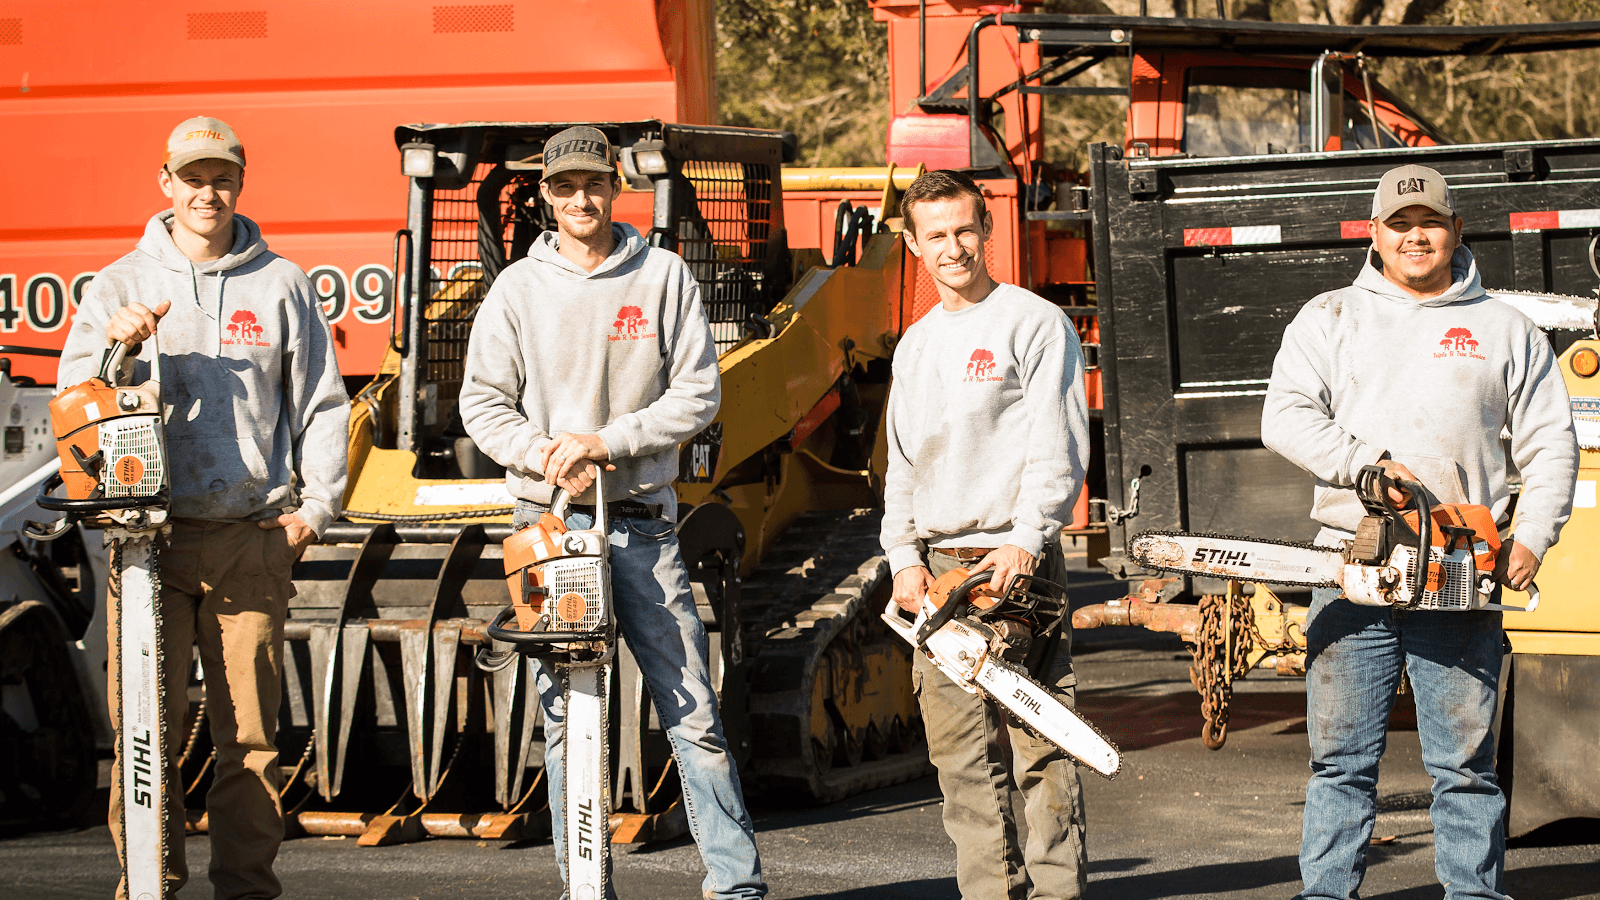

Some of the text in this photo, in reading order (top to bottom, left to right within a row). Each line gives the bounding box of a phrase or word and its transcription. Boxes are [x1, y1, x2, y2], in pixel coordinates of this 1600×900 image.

[184, 129, 225, 141] STIHL
[546, 139, 603, 166] STIHL
[1397, 177, 1426, 196] CAT
[692, 443, 710, 478] CAT
[1192, 547, 1251, 567] STIHL
[1428, 571, 1445, 579] TIHL
[954, 624, 970, 637] STIHL
[1012, 688, 1044, 716] STIHL
[133, 730, 152, 809] STIHL
[578, 798, 593, 861] STIHL
